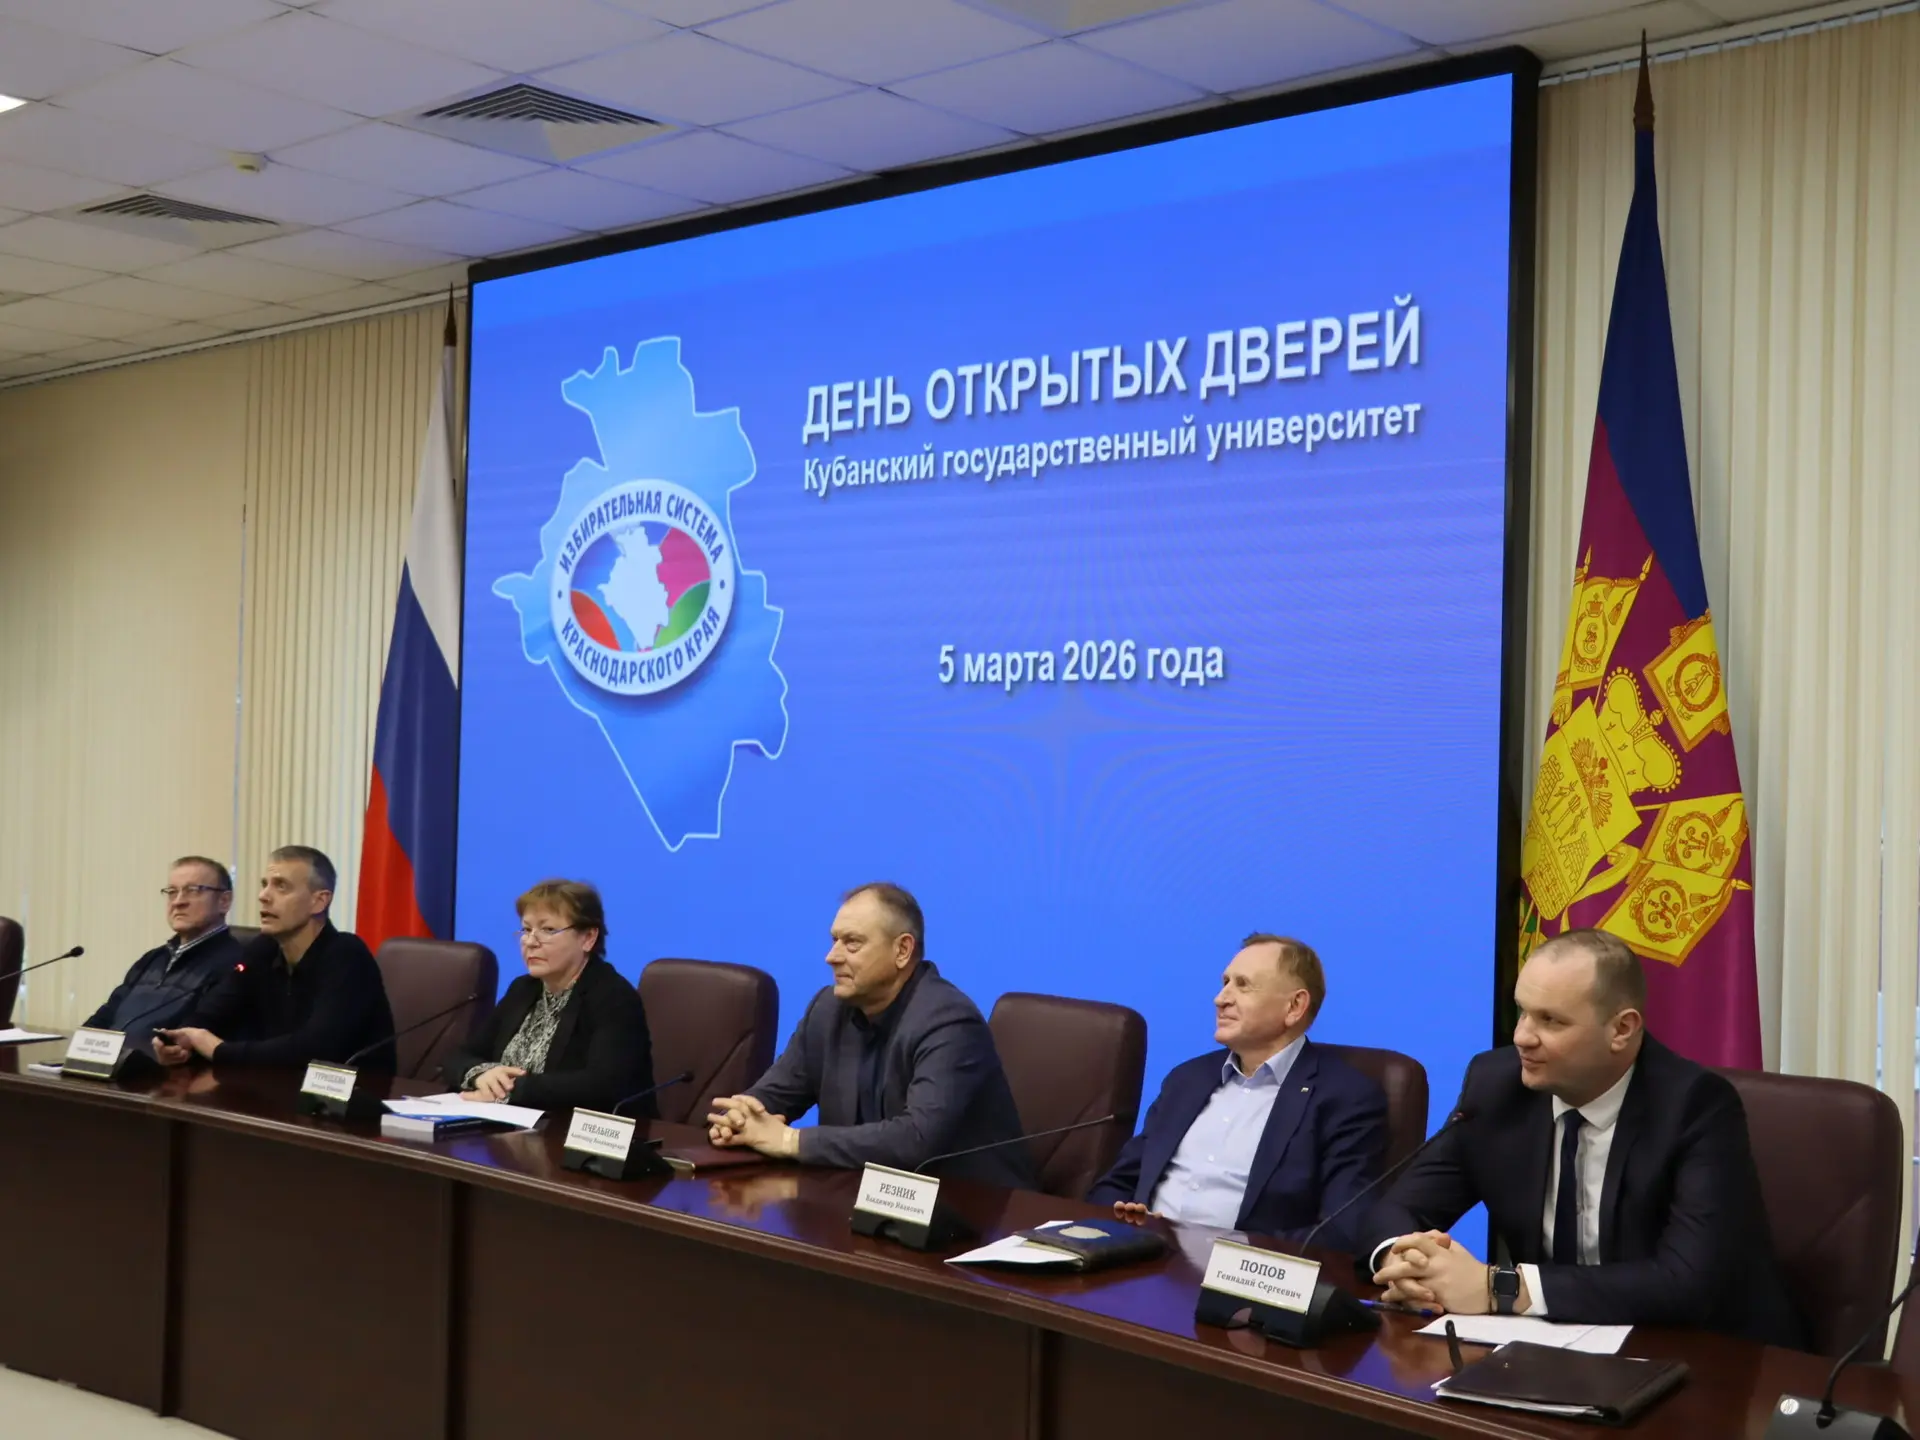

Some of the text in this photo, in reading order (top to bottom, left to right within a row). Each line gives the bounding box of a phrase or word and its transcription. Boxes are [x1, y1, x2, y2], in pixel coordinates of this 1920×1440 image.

[802, 294, 1420, 444] ДЕНЬ ОТКРЫТЫХ ДВЕРЕЙ
[804, 402, 1421, 497] Кубанский государственный университет
[560, 491, 724, 574] ИЗБИРАТЕЛЬНАЯ СИСТЕМА
[561, 606, 721, 687] КРАСНОДАРСКОГО КРАЯ
[938, 640, 1224, 692] 5 марта 2026 года
[879, 1183, 917, 1201] РЕЗНИК
[1216, 1270, 1302, 1299] Геннадий Сергеевич
[1240, 1259, 1286, 1281] ПОПОВ
